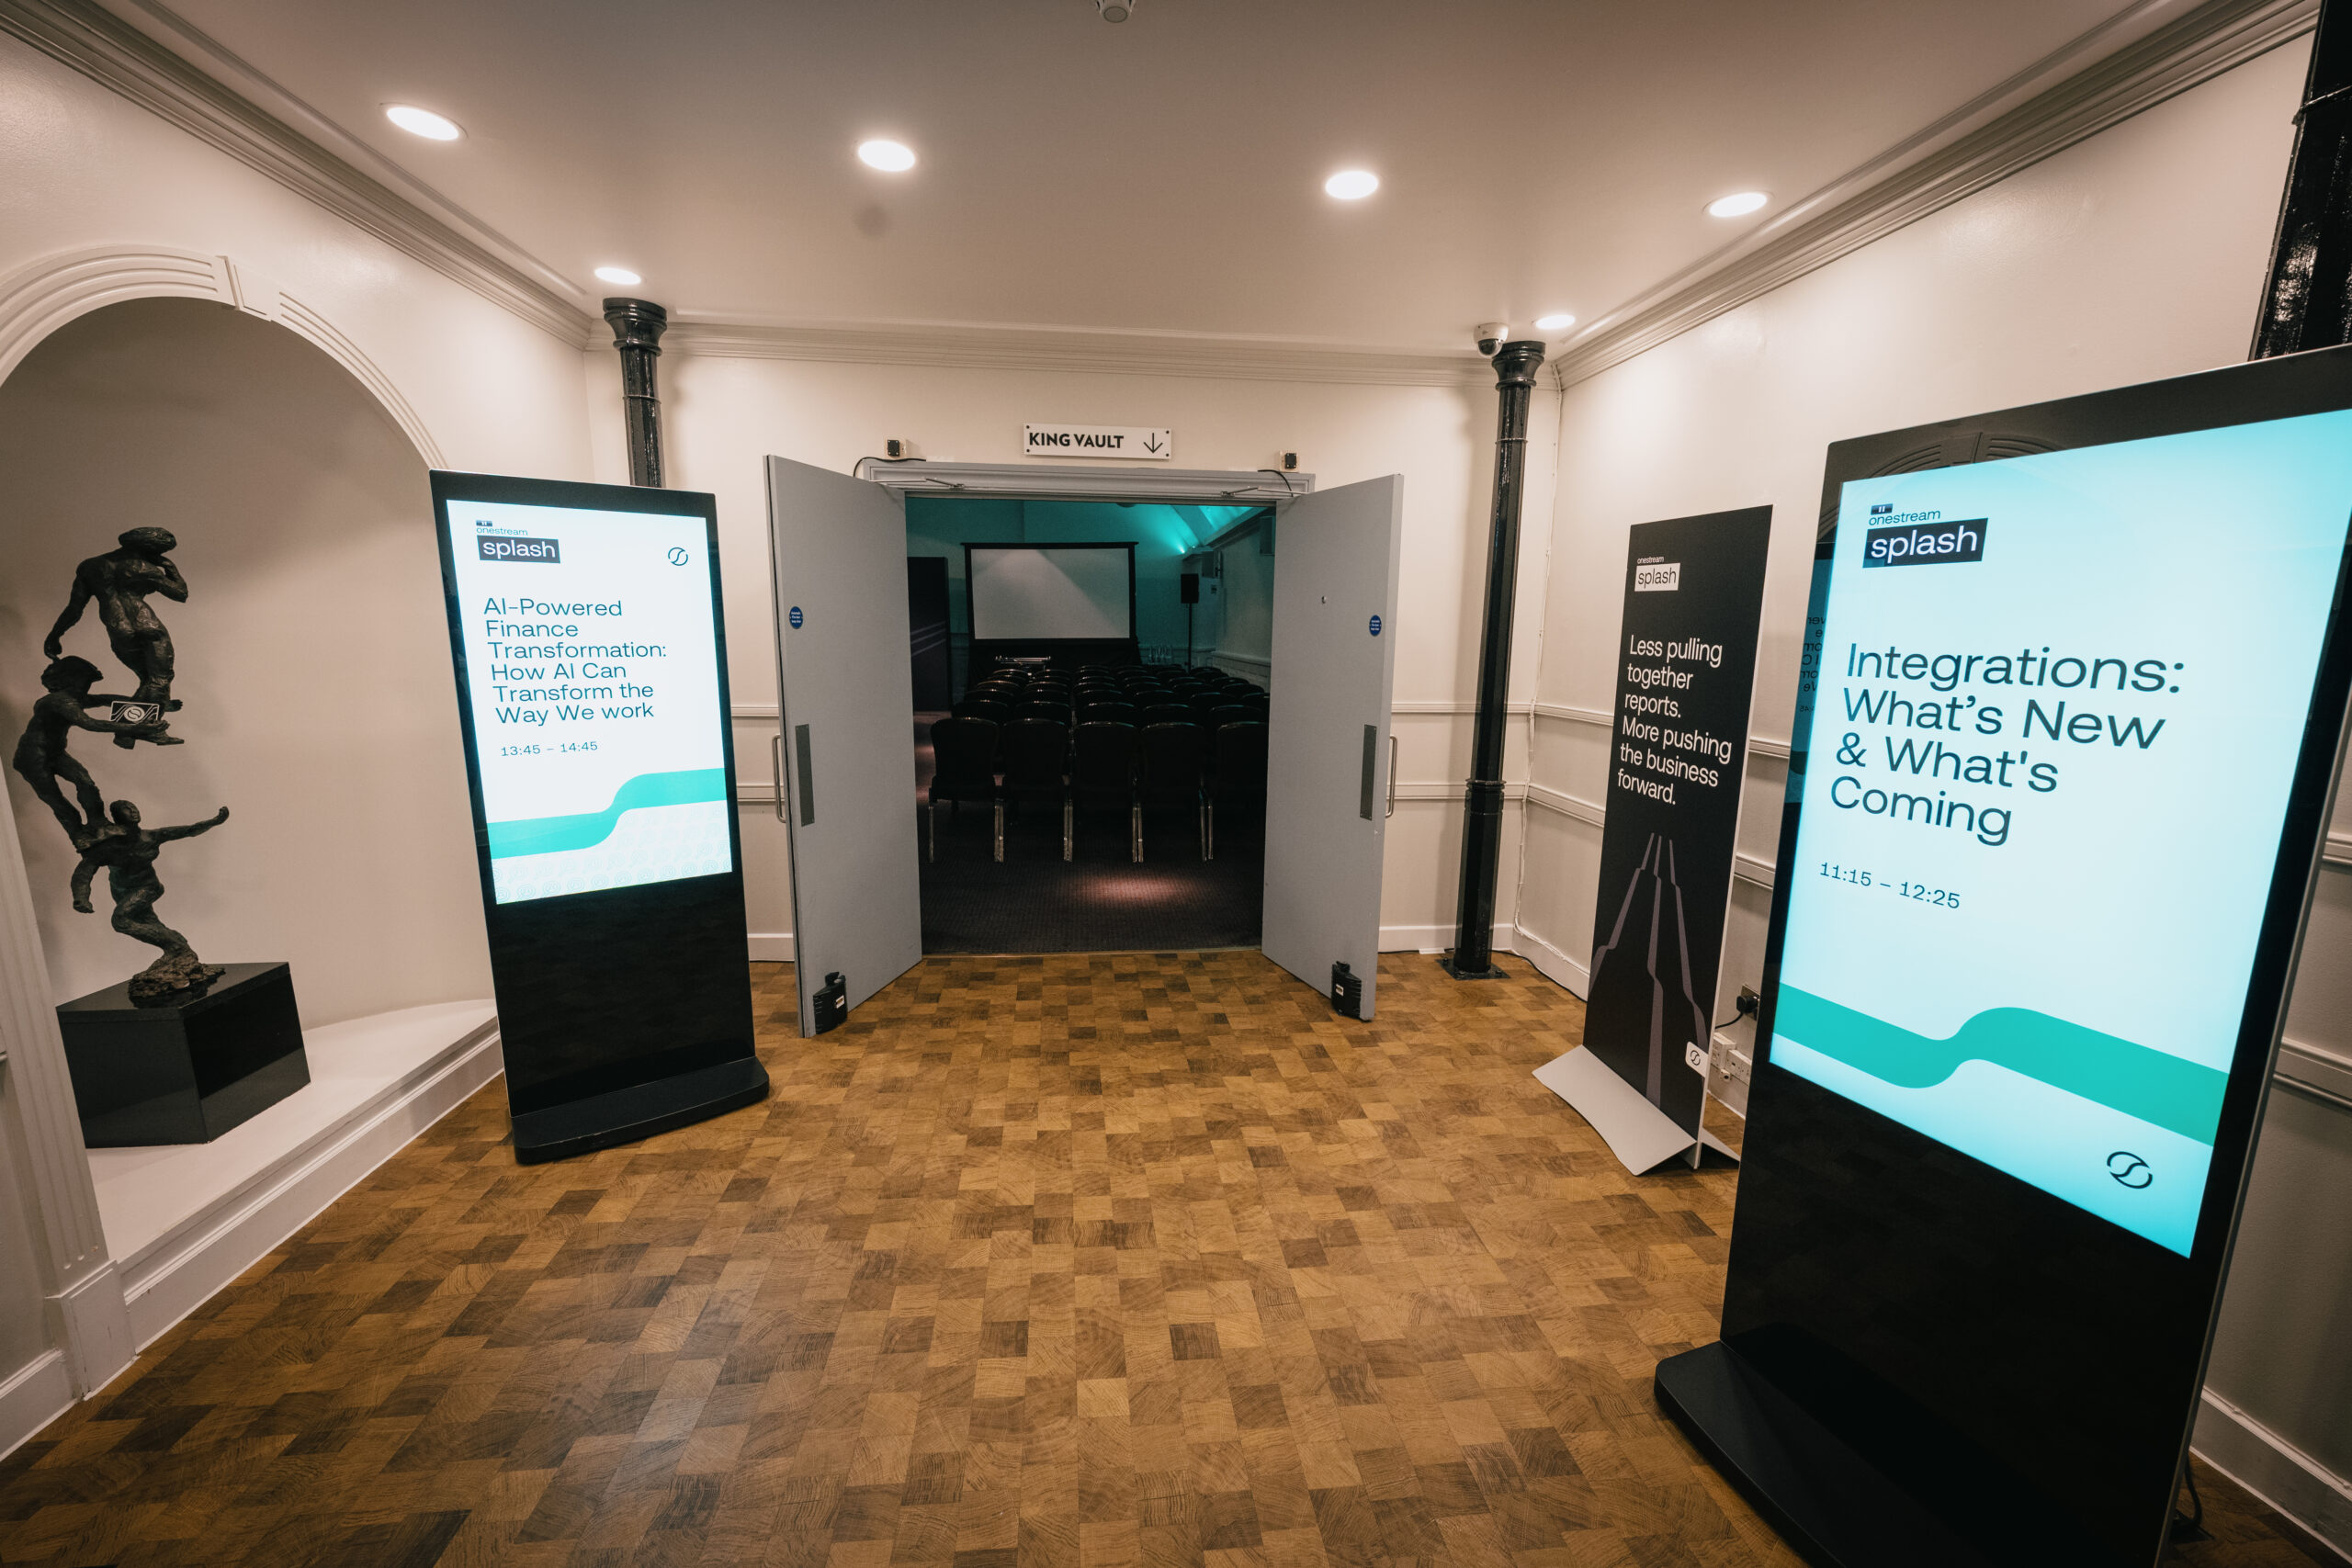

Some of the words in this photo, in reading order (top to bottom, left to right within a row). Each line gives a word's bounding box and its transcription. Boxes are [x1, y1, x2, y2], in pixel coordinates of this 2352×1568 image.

[1029, 433, 1070, 446] KING
[1073, 434, 1124, 448] VAULT
[1869, 510, 1940, 525] onestream
[476, 526, 528, 536] onestream
[483, 539, 555, 559] splash
[1871, 525, 1977, 563] splash
[1638, 568, 1676, 588] splash
[484, 598, 622, 616] AI-Powered
[486, 620, 578, 637] Finance
[487, 641, 666, 659] Transformation:
[1630, 635, 1663, 657] Less
[1667, 637, 1723, 668] pulling
[492, 664, 545, 681] How
[553, 663, 574, 679] AI
[582, 662, 627, 679] Can
[1627, 665, 1693, 689] together
[1848, 643, 2184, 693] Integrations:
[492, 684, 613, 702] Transform
[619, 682, 653, 698] the
[495, 706, 548, 727] Way
[556, 705, 594, 721] We
[601, 702, 654, 719] work
[1624, 694, 1680, 718] reports.
[2023, 699, 2165, 749] New
[501, 744, 540, 757] 13:45
[560, 741, 598, 752] 14:45
[1623, 716, 1659, 742] More
[1663, 728, 1732, 764] pushing
[1837, 732, 1867, 767] &
[1620, 743, 1643, 765] the
[1646, 748, 1718, 787] business
[1618, 770, 1676, 805] forward.
[1831, 776, 2011, 846] Coming
[1820, 863, 1871, 886] 11:15
[1900, 882, 1960, 908] 12:25
